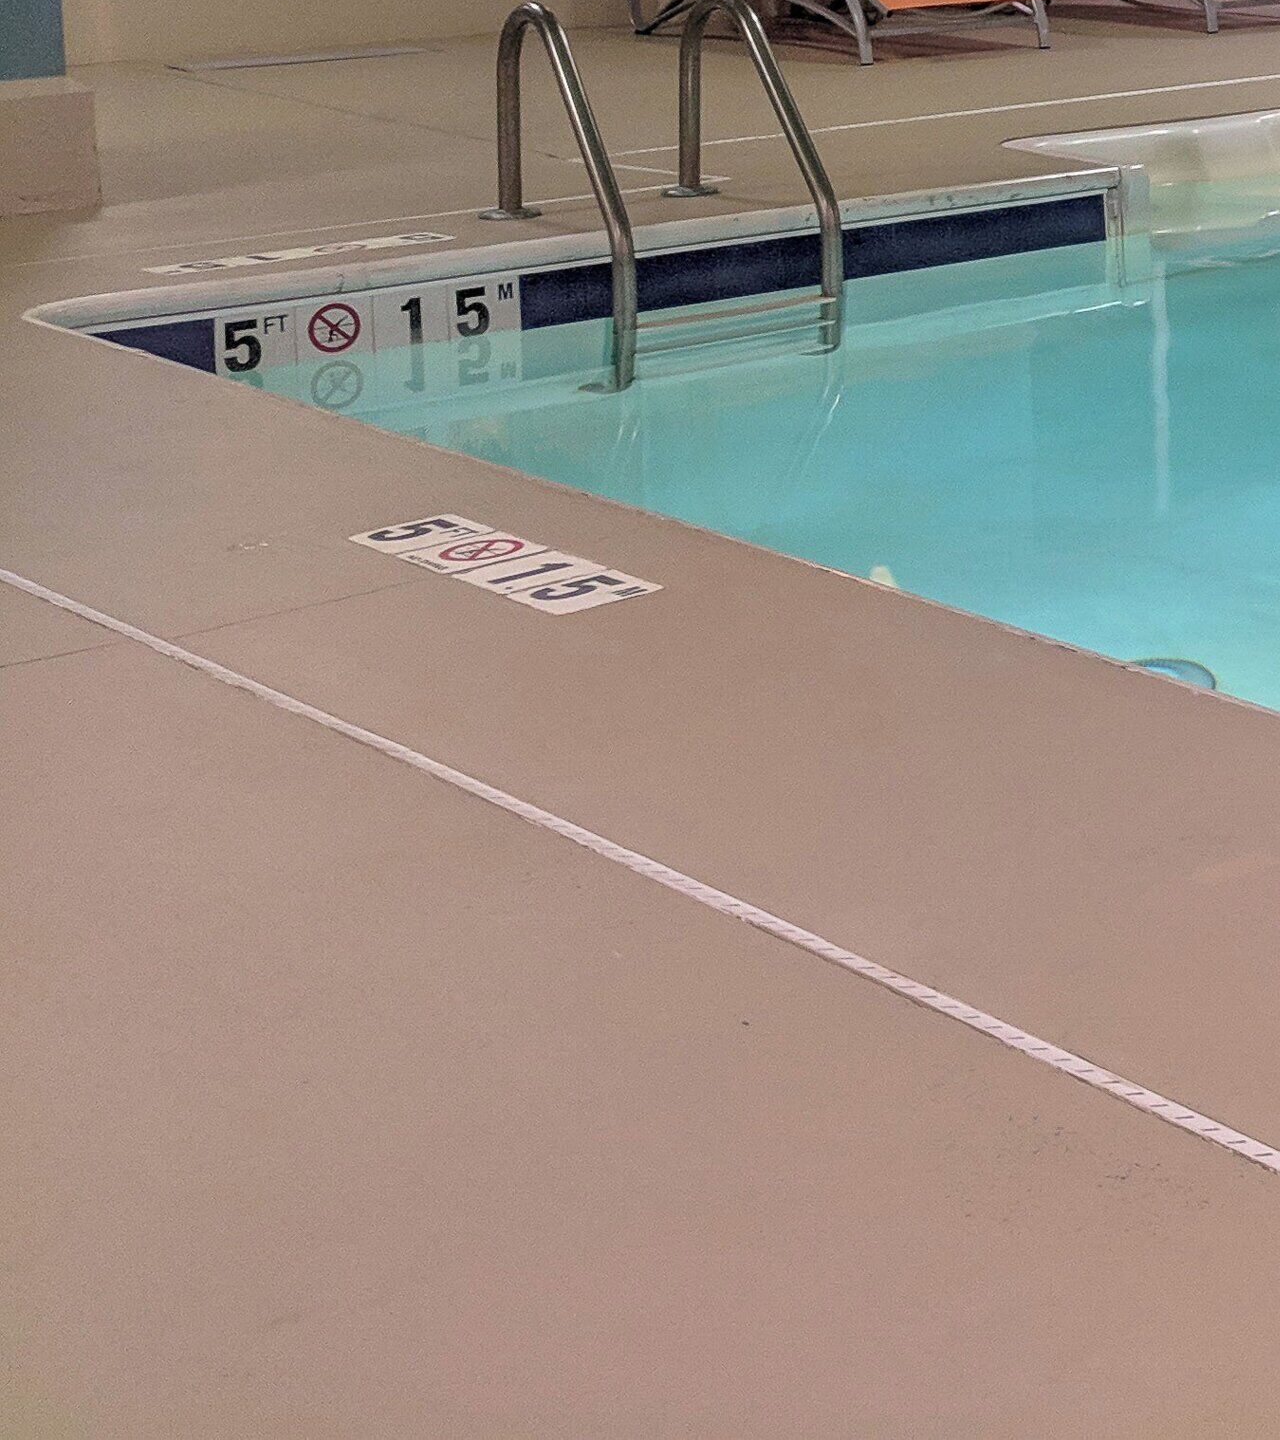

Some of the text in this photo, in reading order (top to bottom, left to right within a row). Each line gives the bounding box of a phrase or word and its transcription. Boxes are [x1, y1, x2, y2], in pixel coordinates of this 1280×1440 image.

[224, 319, 261, 372] 5
[263, 314, 288, 335] FT
[498, 282, 513, 300] M
